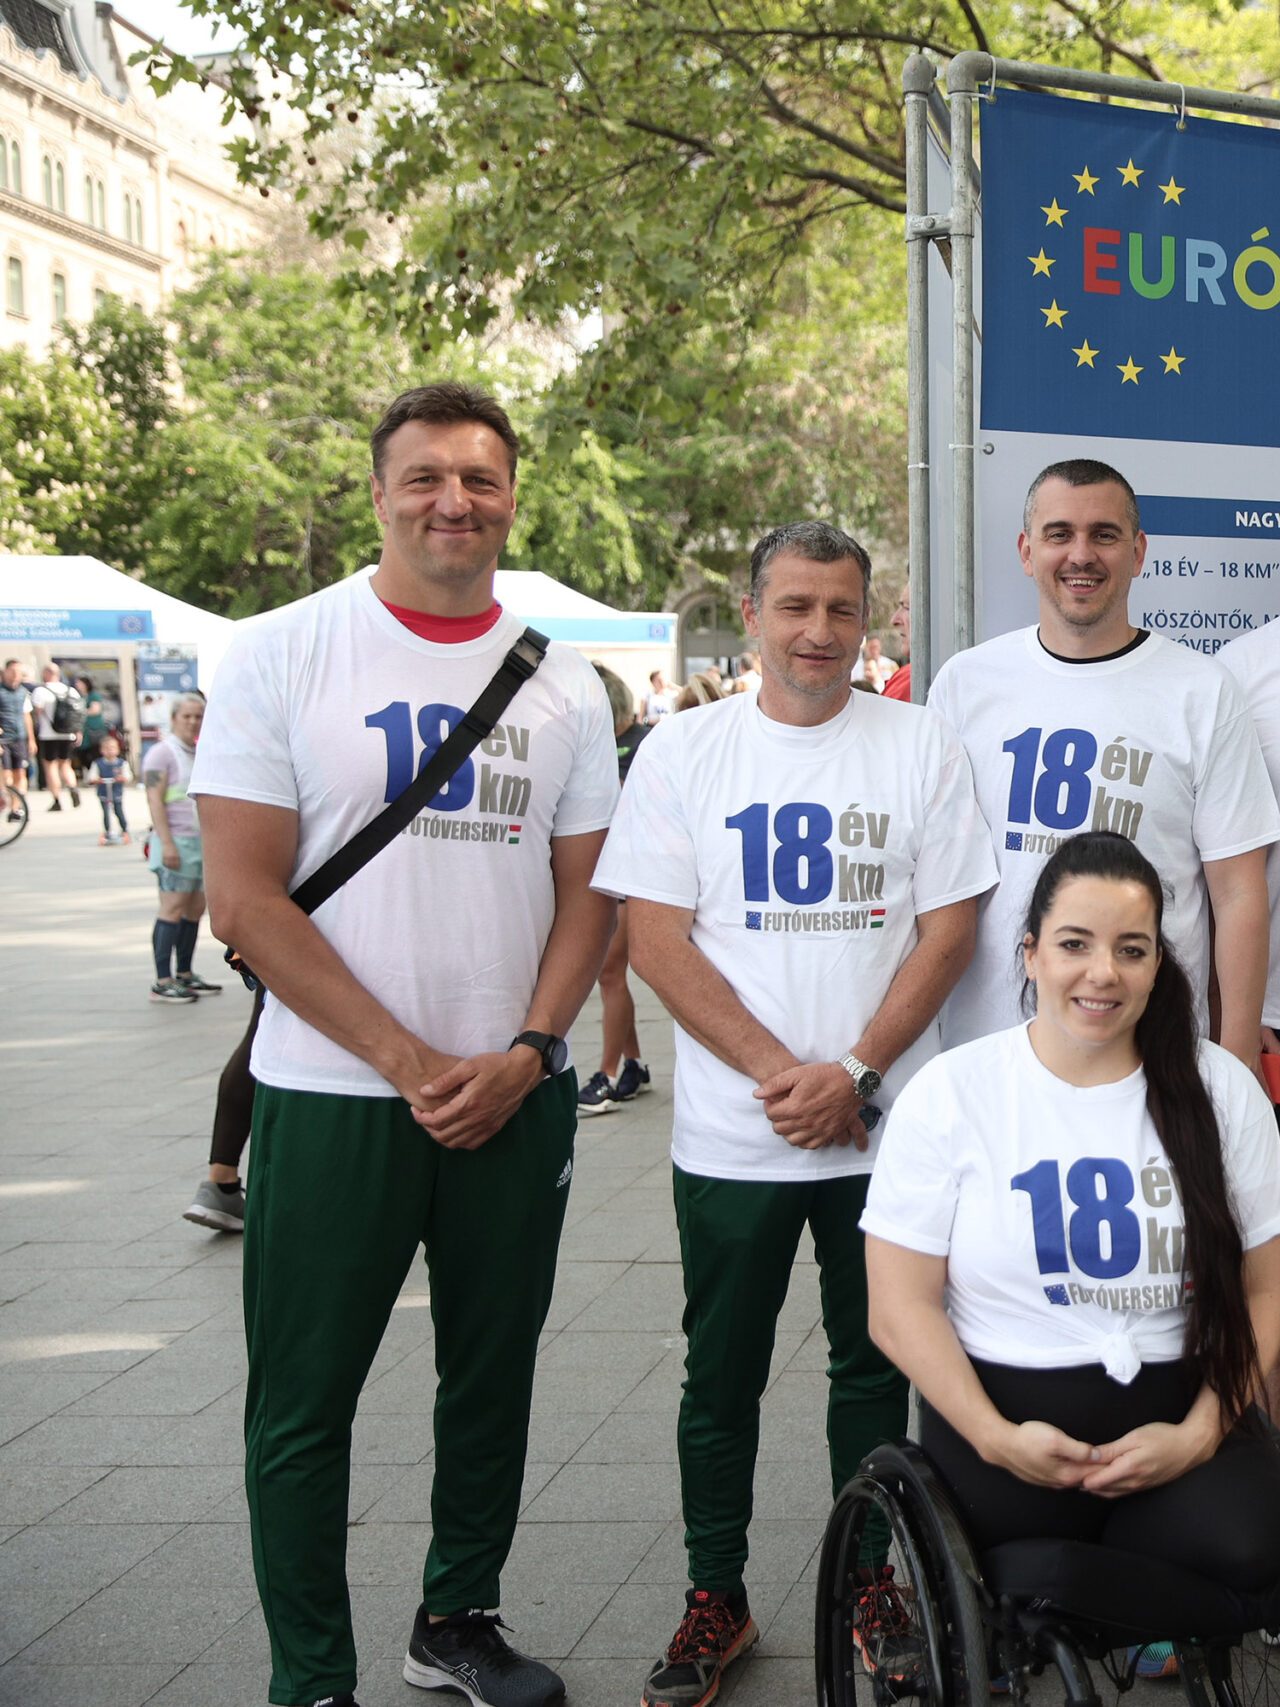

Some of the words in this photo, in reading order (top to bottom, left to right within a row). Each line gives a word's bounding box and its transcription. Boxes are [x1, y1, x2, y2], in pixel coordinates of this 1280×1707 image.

[1178, 556, 1199, 577] ÉV
[1219, 561, 1239, 578] 18
[1143, 608, 1258, 630] KÖSZÖNTŐK,
[479, 763, 532, 817] km
[1002, 727, 1098, 830] 18
[1100, 735, 1154, 787] év
[1091, 786, 1144, 841] km
[725, 802, 833, 905] 18
[838, 803, 890, 849] év
[838, 854, 885, 902] km
[764, 909, 870, 932] FUTÓVERSENY
[1010, 1156, 1141, 1280] 18
